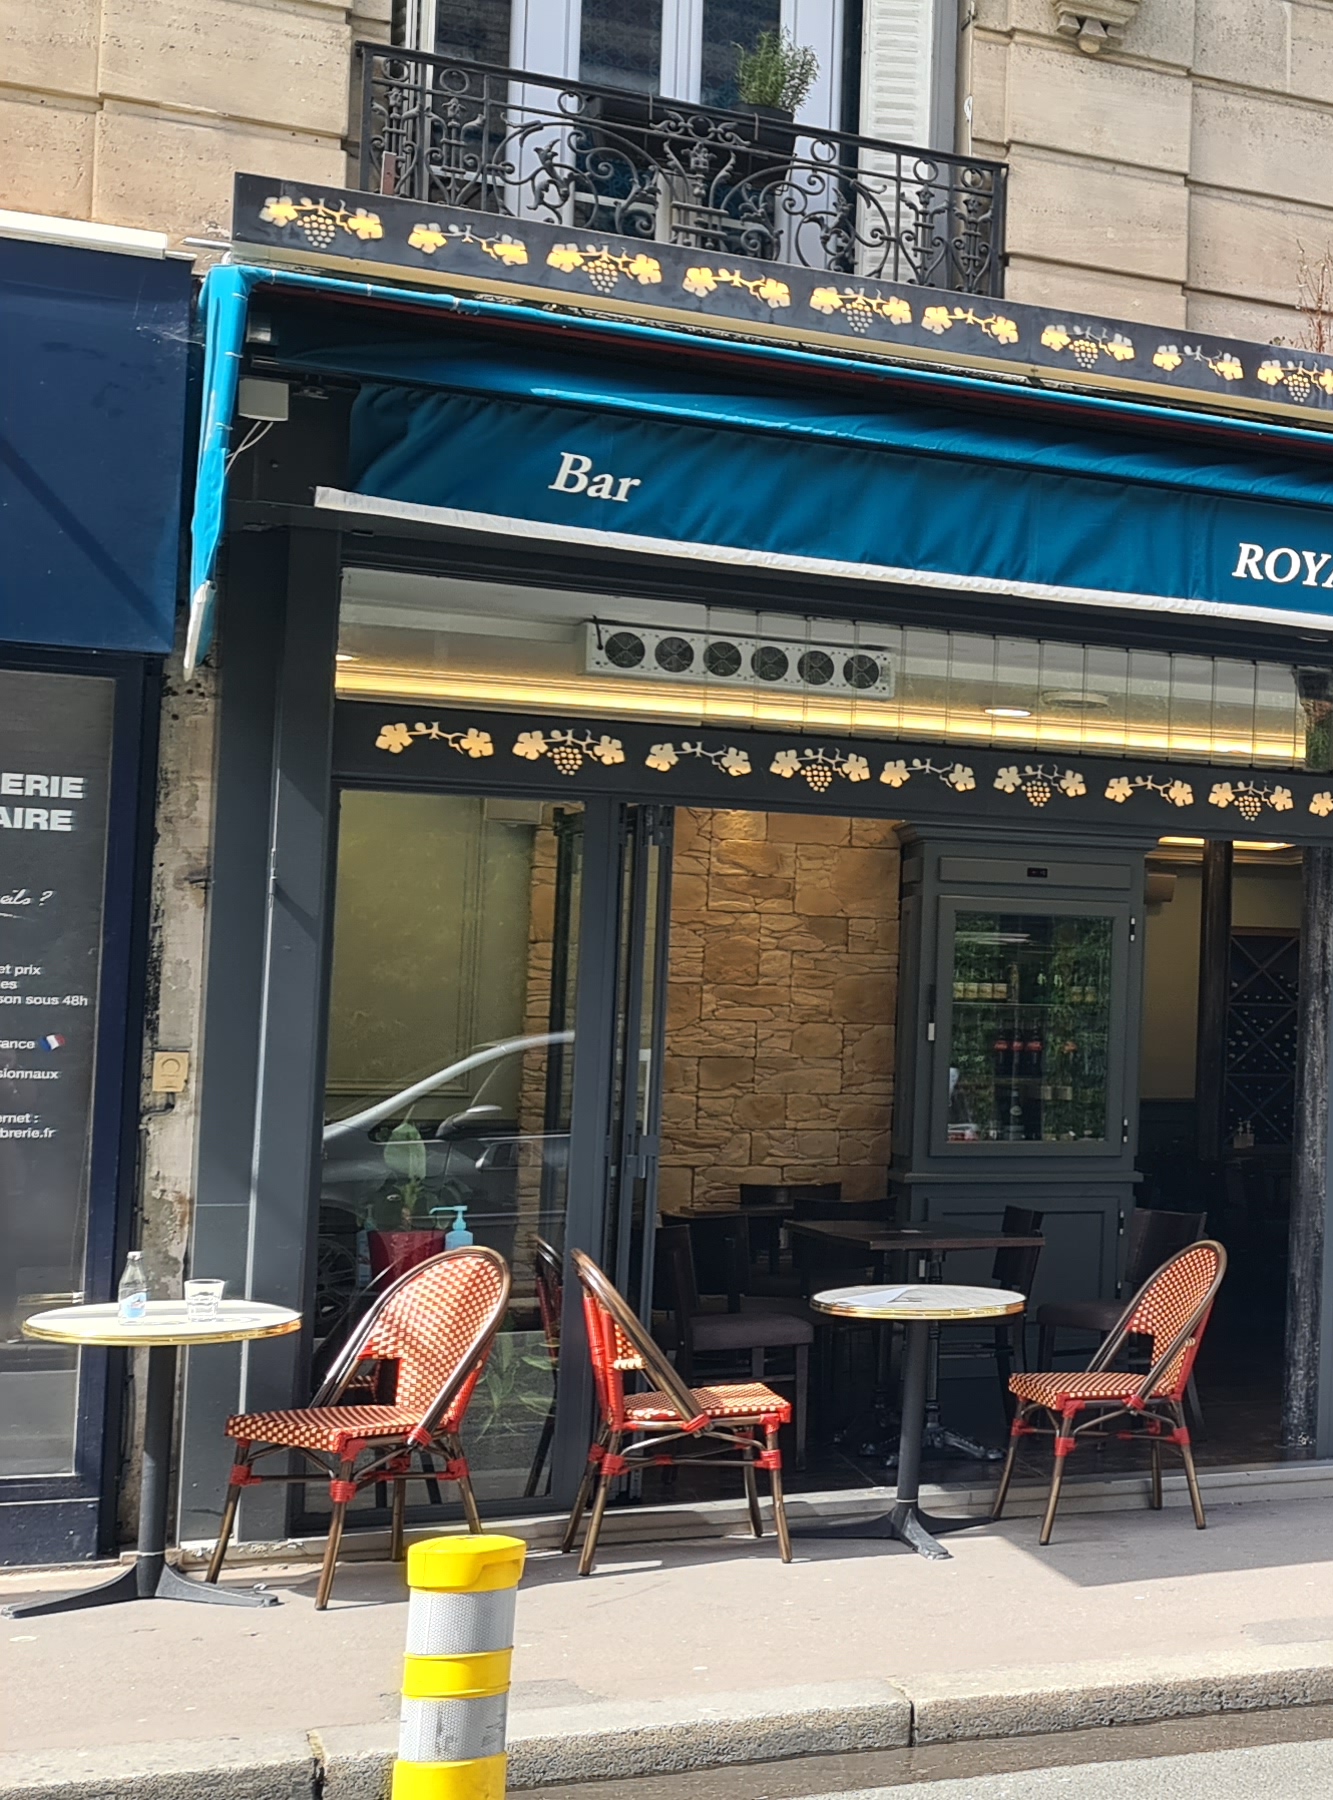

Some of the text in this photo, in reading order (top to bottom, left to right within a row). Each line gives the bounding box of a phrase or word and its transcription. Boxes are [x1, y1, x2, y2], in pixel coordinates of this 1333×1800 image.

[548, 451, 642, 502] Bar
[14, 964, 41, 976] prix
[25, 996, 59, 1006] sous
[62, 995, 88, 1006] 48h
